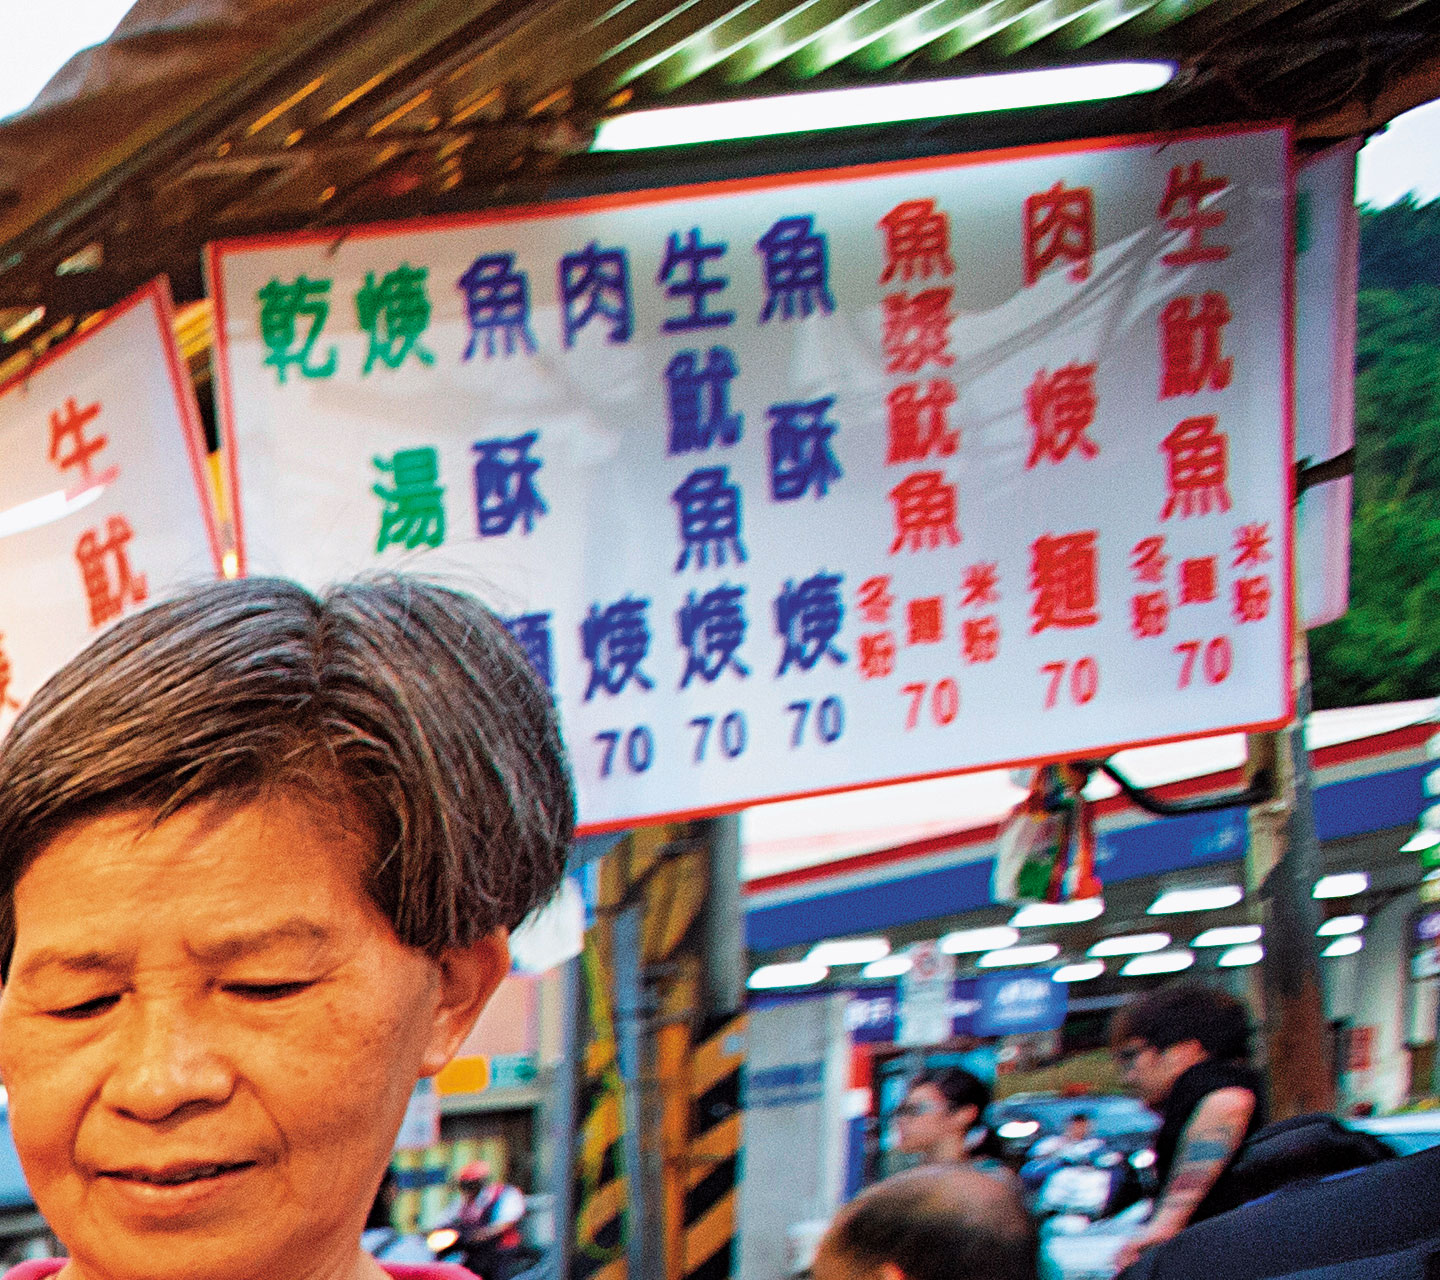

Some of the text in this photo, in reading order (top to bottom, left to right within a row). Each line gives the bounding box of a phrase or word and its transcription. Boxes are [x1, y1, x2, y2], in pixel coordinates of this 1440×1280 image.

[1039, 656, 1100, 709] 70
[1172, 635, 1233, 689] 70
[786, 695, 846, 750] 70
[899, 678, 960, 731] 70
[594, 724, 656, 779] 70
[688, 708, 749, 766] 70
